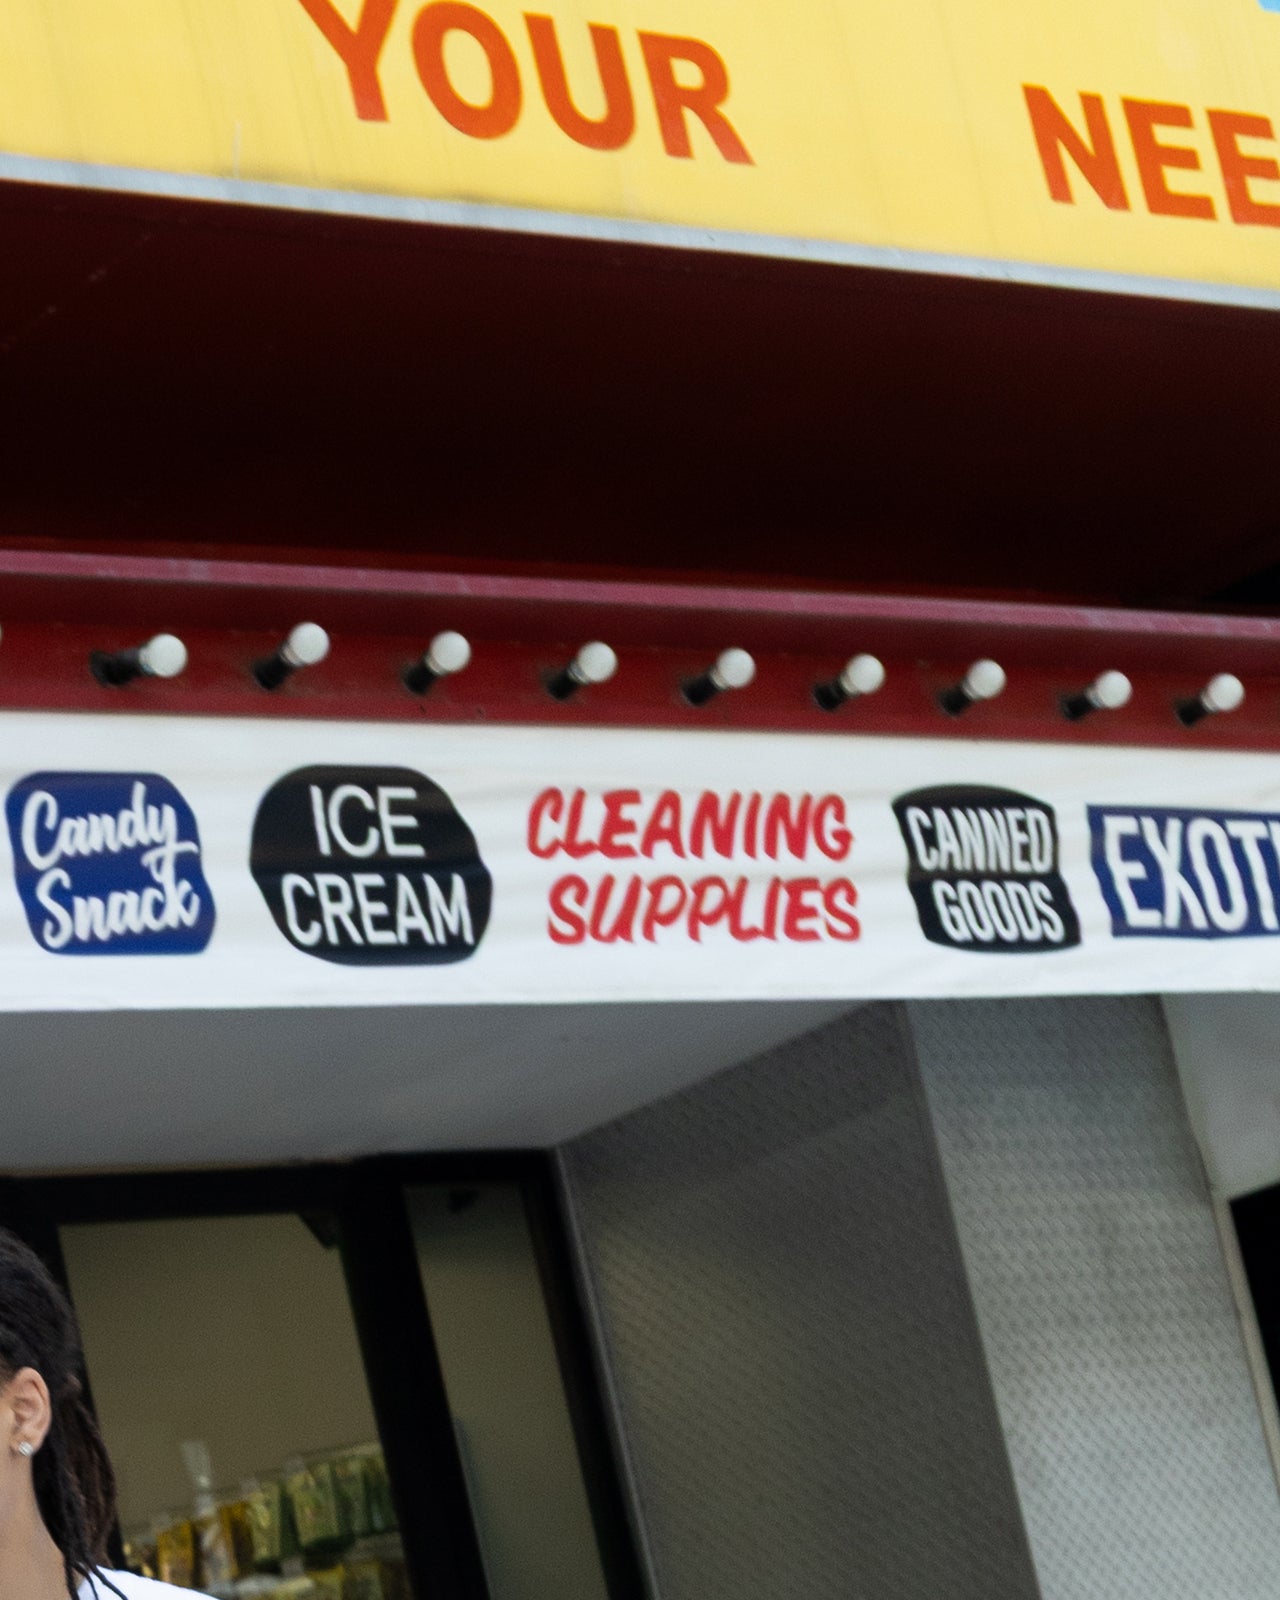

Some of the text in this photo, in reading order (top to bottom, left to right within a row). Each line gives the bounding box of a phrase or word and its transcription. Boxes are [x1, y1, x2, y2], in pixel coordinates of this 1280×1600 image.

[298, 0, 755, 166] YOUR
[21, 780, 200, 878] Candy
[309, 784, 426, 859] ICE
[527, 787, 855, 863] CLEANING
[904, 805, 1054, 875] CANNED
[35, 845, 201, 950] Snack
[280, 872, 476, 947] CREAM
[547, 873, 862, 946] SUPPLIES
[931, 879, 1066, 944] GOODS
